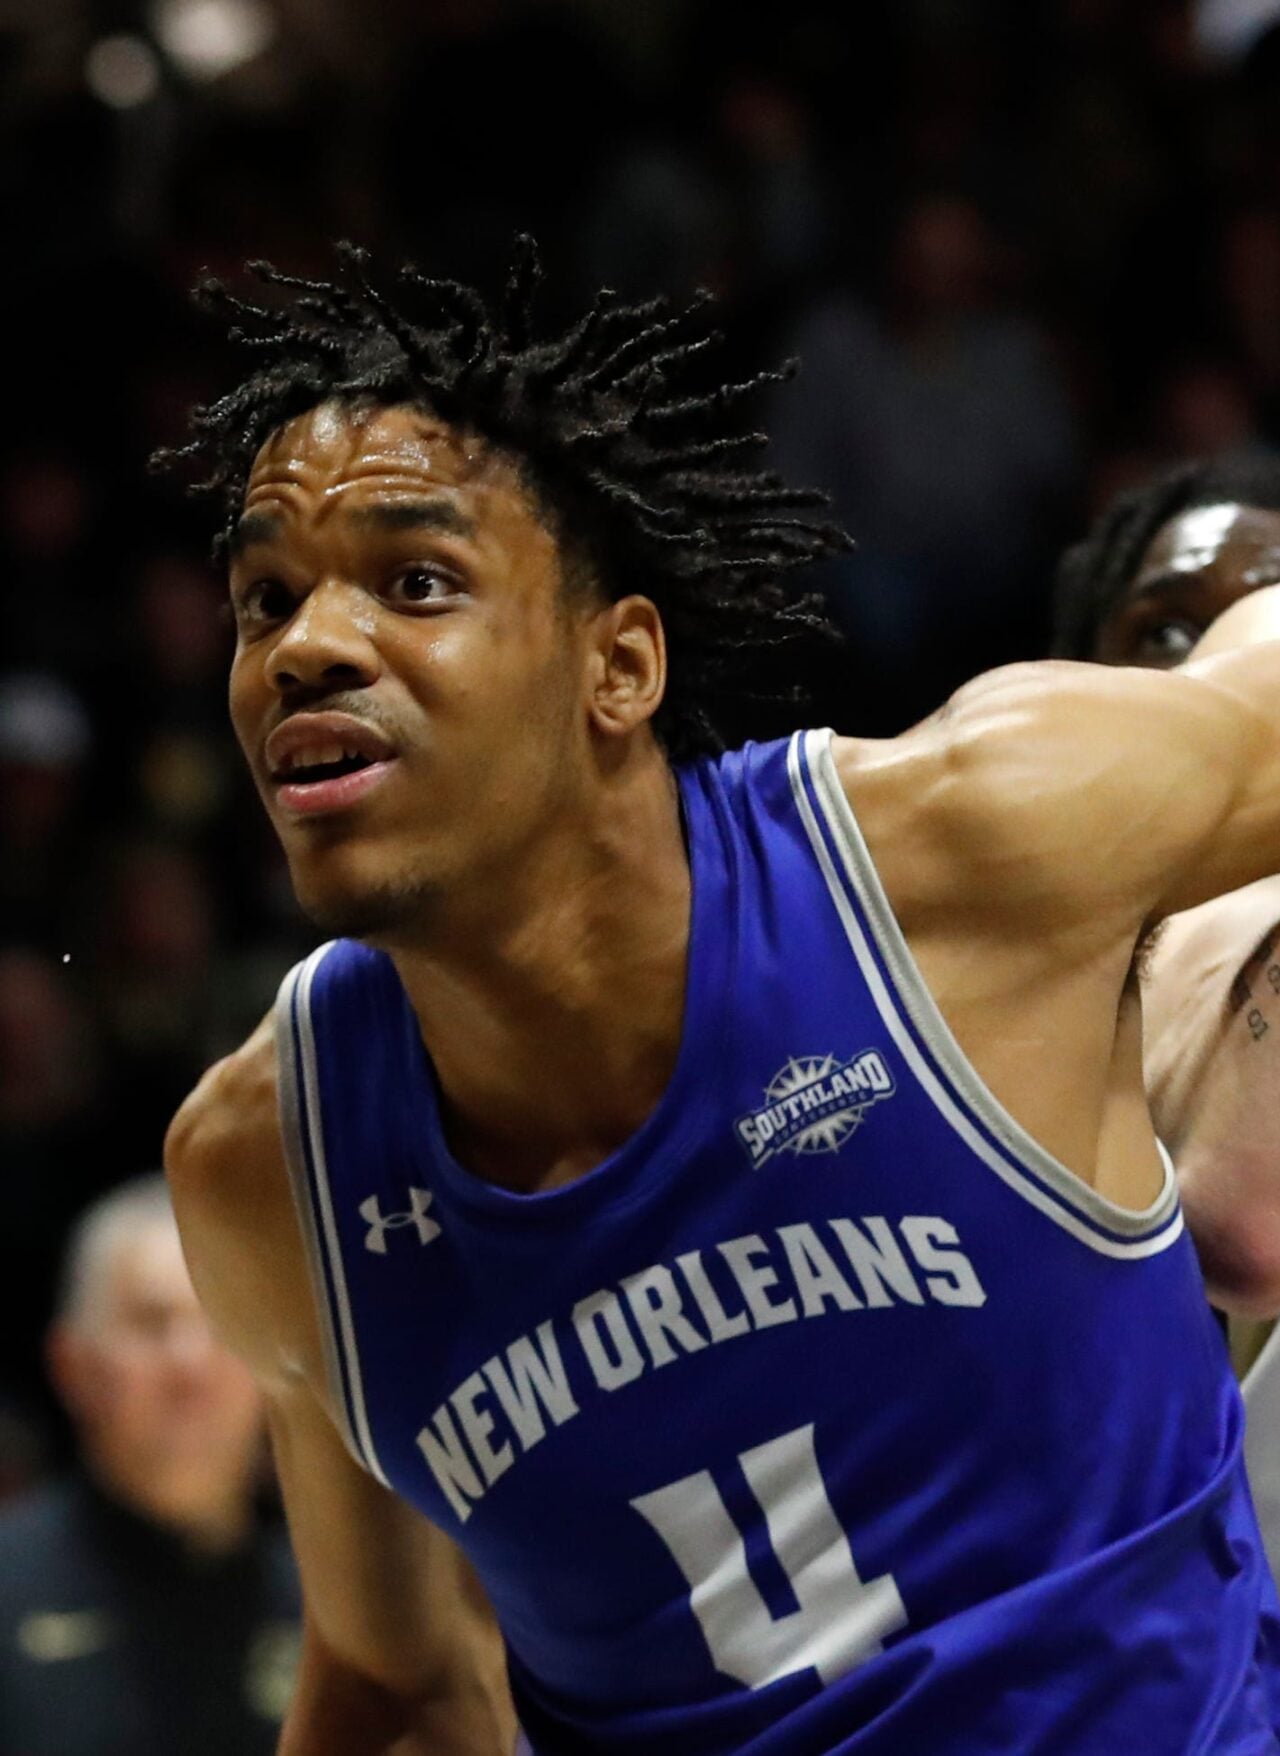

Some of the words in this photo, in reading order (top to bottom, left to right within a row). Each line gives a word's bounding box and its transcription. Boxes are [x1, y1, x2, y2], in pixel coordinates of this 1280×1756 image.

[738, 1051, 892, 1158] SOUTHLAND
[415, 1319, 579, 1524] NEW
[571, 1215, 988, 1393] ORLEANS
[628, 1422, 909, 1692] 4
